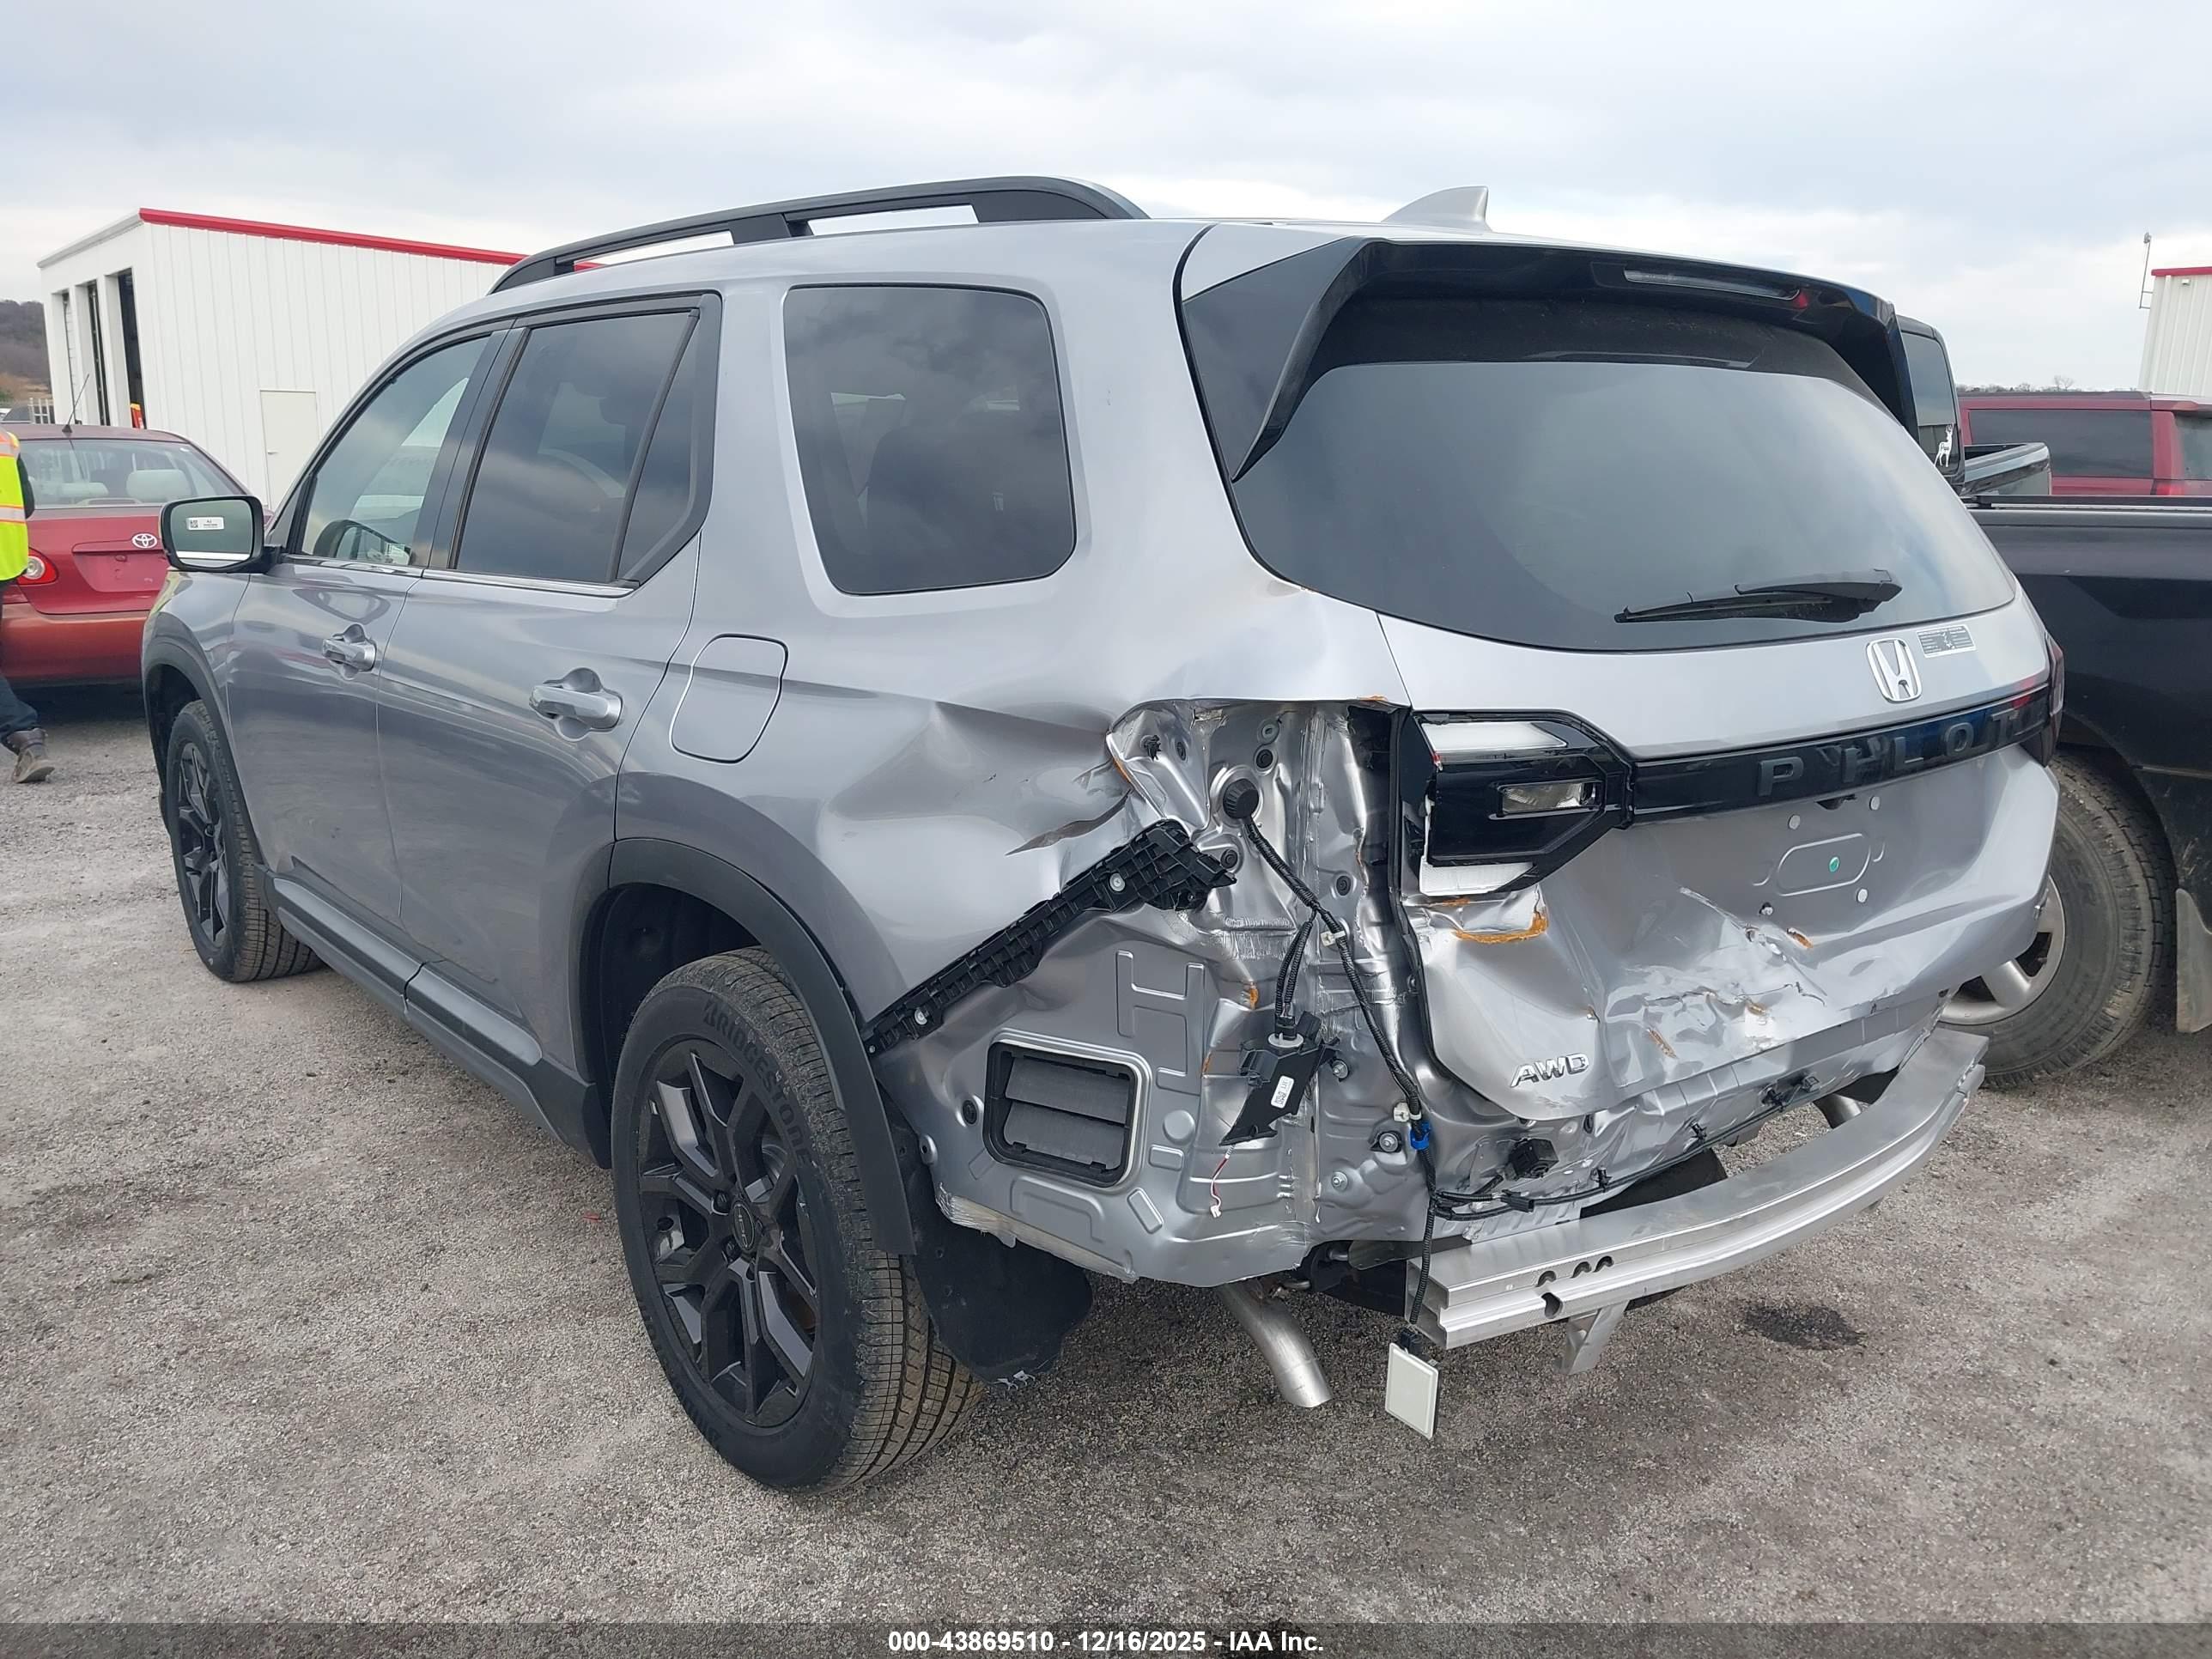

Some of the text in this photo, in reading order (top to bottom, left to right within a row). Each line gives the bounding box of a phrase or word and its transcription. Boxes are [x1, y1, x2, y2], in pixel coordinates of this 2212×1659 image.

[1758, 707, 2019, 797] PILOT
[702, 999, 811, 1164] BRIDGESTONE
[1509, 1052, 1589, 1088] AWD
